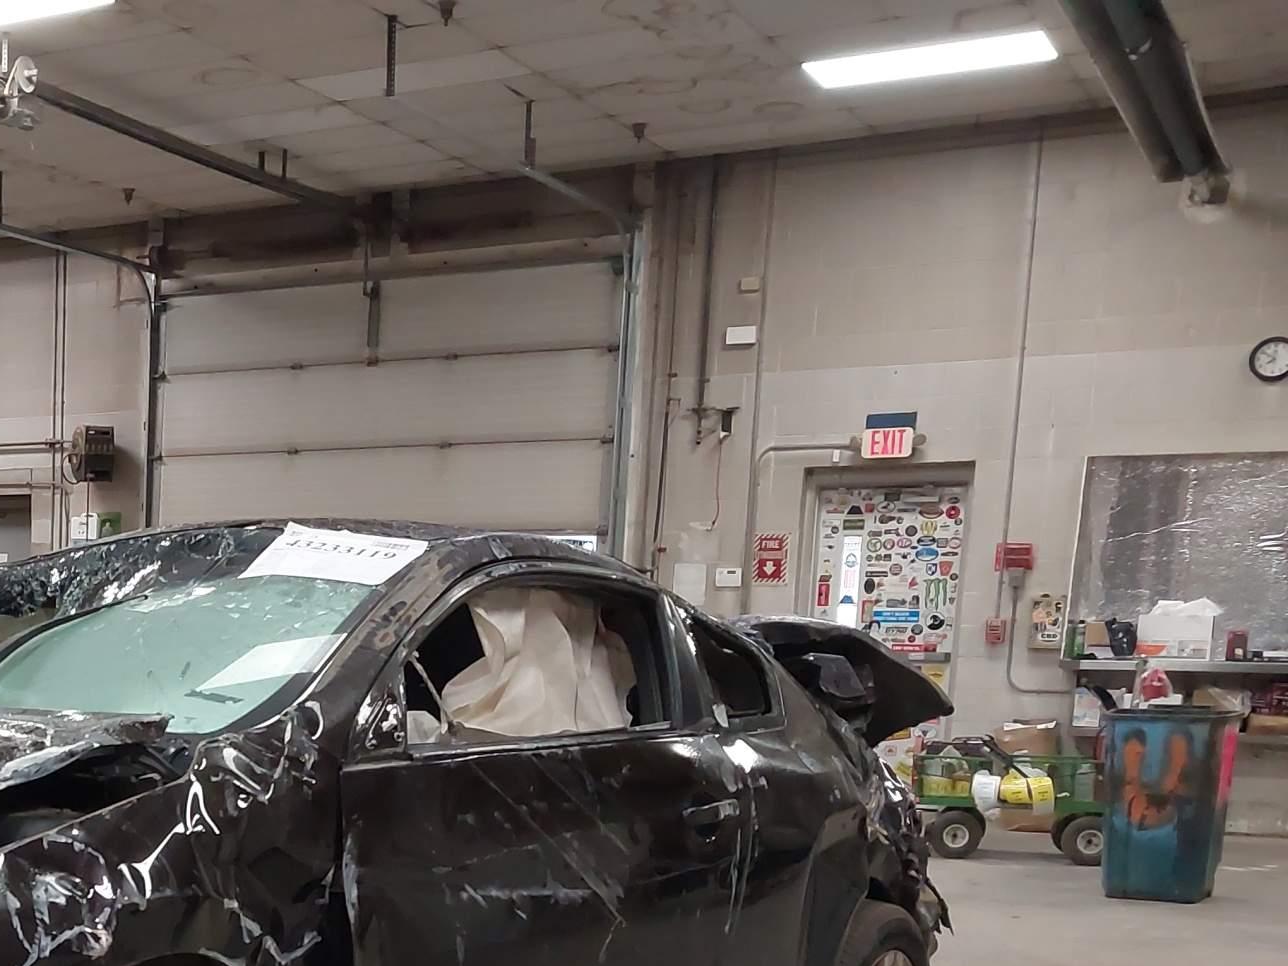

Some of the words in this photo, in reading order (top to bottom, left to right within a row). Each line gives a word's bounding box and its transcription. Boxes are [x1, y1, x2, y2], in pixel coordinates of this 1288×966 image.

[870, 430, 906, 456] EXIT
[285, 540, 398, 559] 43233119
[761, 540, 780, 549] FIRE
